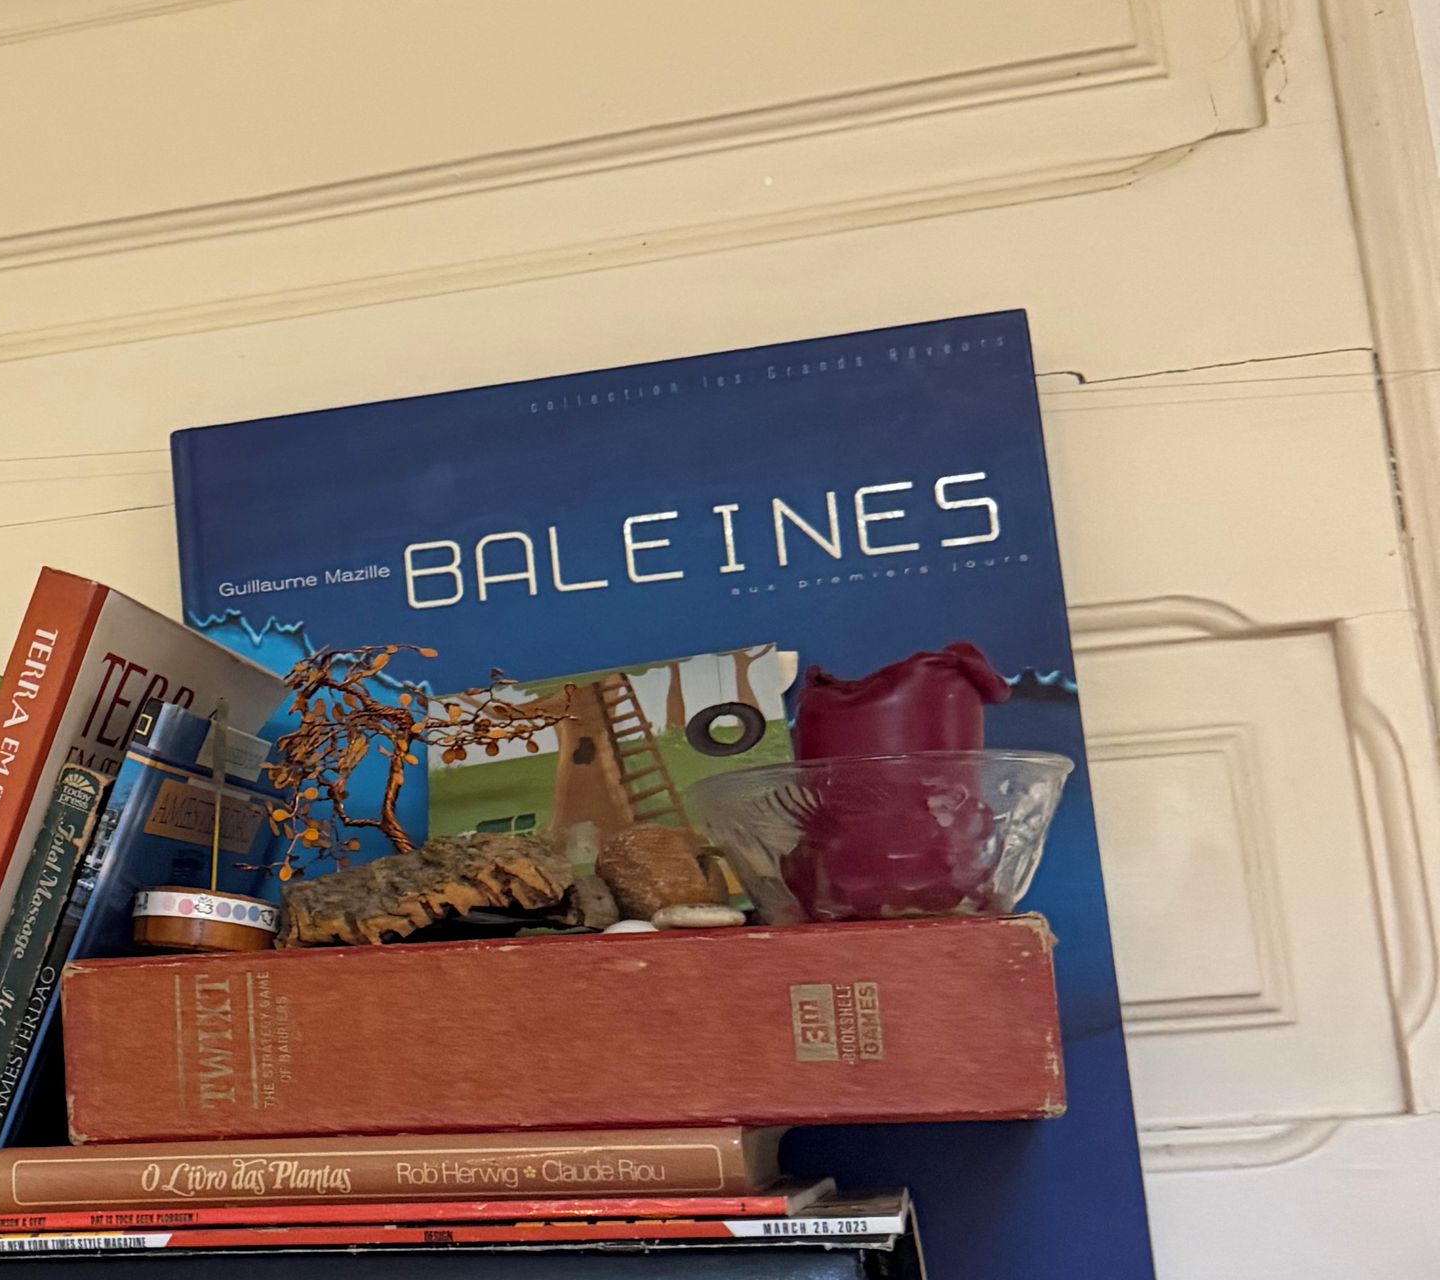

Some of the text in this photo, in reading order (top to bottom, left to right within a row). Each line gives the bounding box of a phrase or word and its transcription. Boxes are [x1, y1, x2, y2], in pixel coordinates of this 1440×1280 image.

[529, 379, 679, 414] collection
[702, 370, 744, 390] les
[766, 354, 865, 381] Grands
[402, 470, 1003, 612] BALEINES
[218, 561, 392, 600] Guillaume Mazille
[731, 553, 1030, 597] aux premiers jours
[3, 627, 59, 729] TERRA
[58, 793, 89, 810] press
[62, 786, 93, 802] today
[13, 823, 75, 960] Total Massage
[194, 974, 236, 1109] TWIXT
[257, 970, 276, 1109] THE STRATEGY GAME
[835, 983, 858, 1061] BOOKSHELF
[858, 985, 880, 1056] GAMES
[141, 1158, 352, 1197] O Livro das Plantas
[396, 1158, 667, 1188] Rob Herwig Claude Riou
[7, 1239, 26, 1252] NEW
[27, 1238, 50, 1251] YORK
[50, 1238, 77, 1250] TIMES
[77, 1237, 103, 1250] STYLE
[104, 1236, 148, 1249] MAGAZINE
[763, 1221, 807, 1236] MARCH
[837, 1220, 869, 1234] 2023
